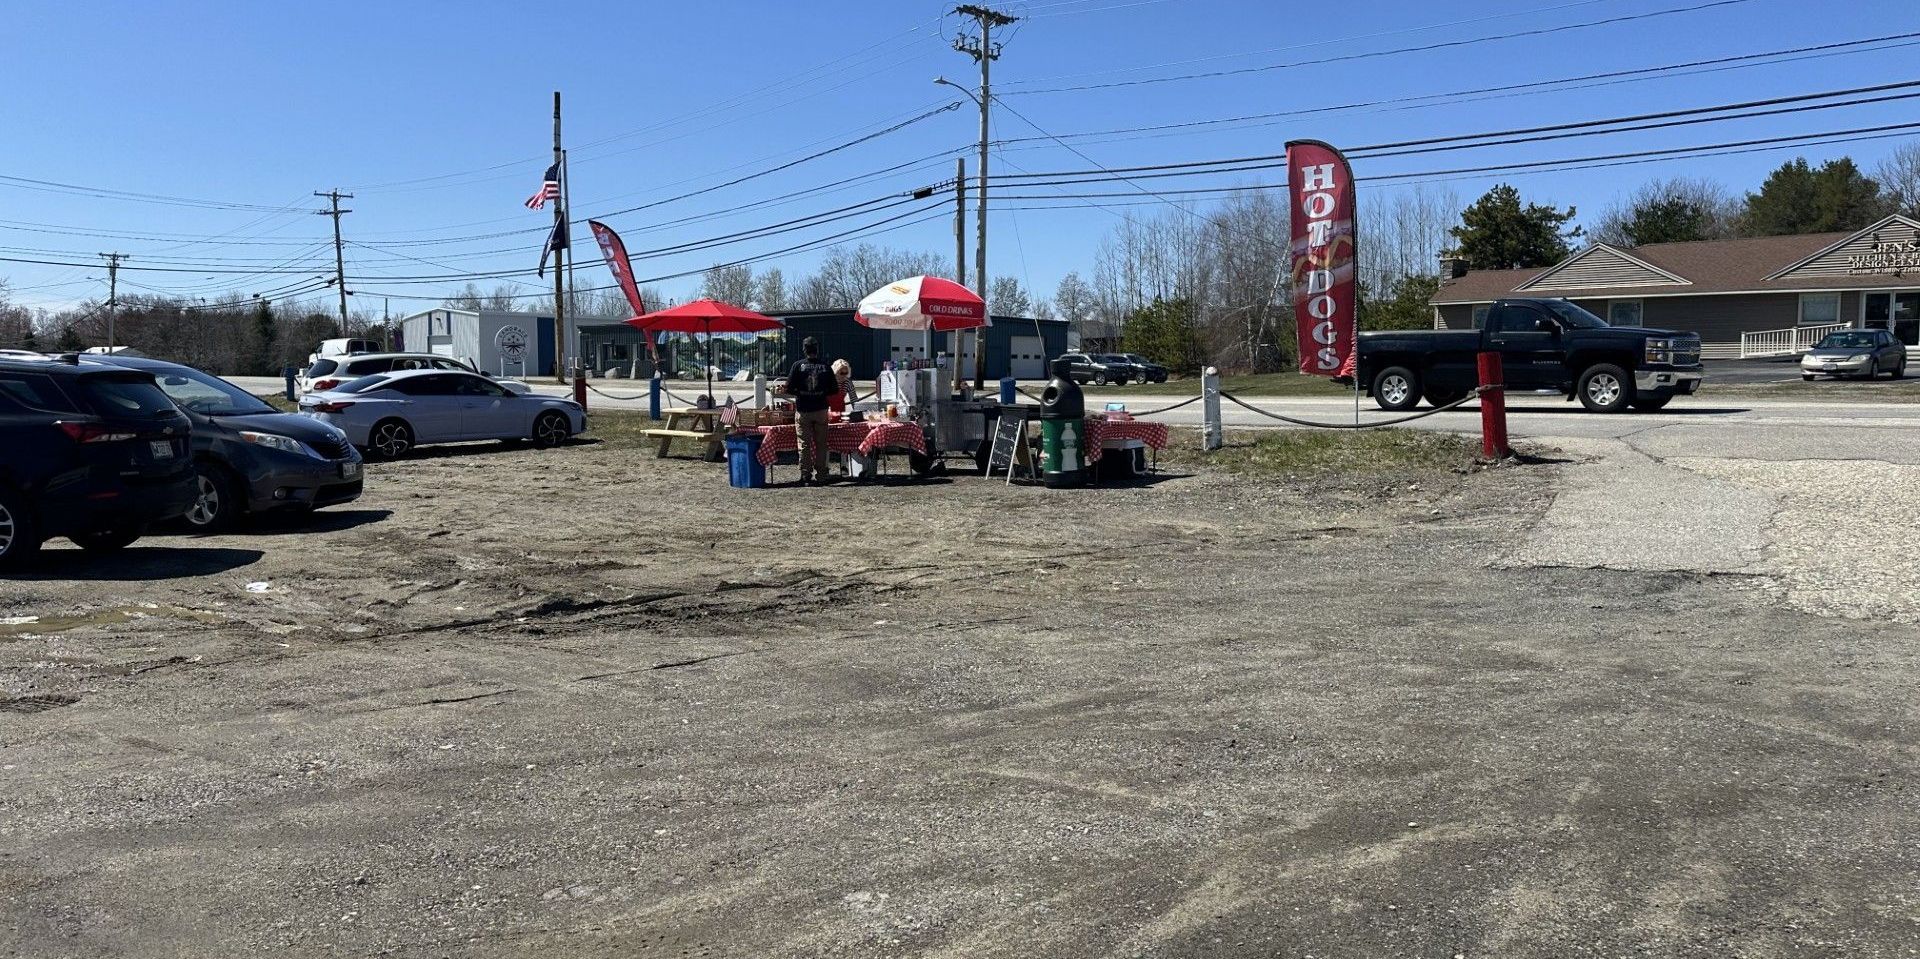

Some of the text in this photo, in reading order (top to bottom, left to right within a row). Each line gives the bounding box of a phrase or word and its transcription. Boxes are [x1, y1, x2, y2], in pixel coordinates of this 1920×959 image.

[1302, 163, 1340, 370] HOT DOGS
[1852, 260, 1888, 268] DESIGN
[929, 305, 973, 315] COLD DRINKS
